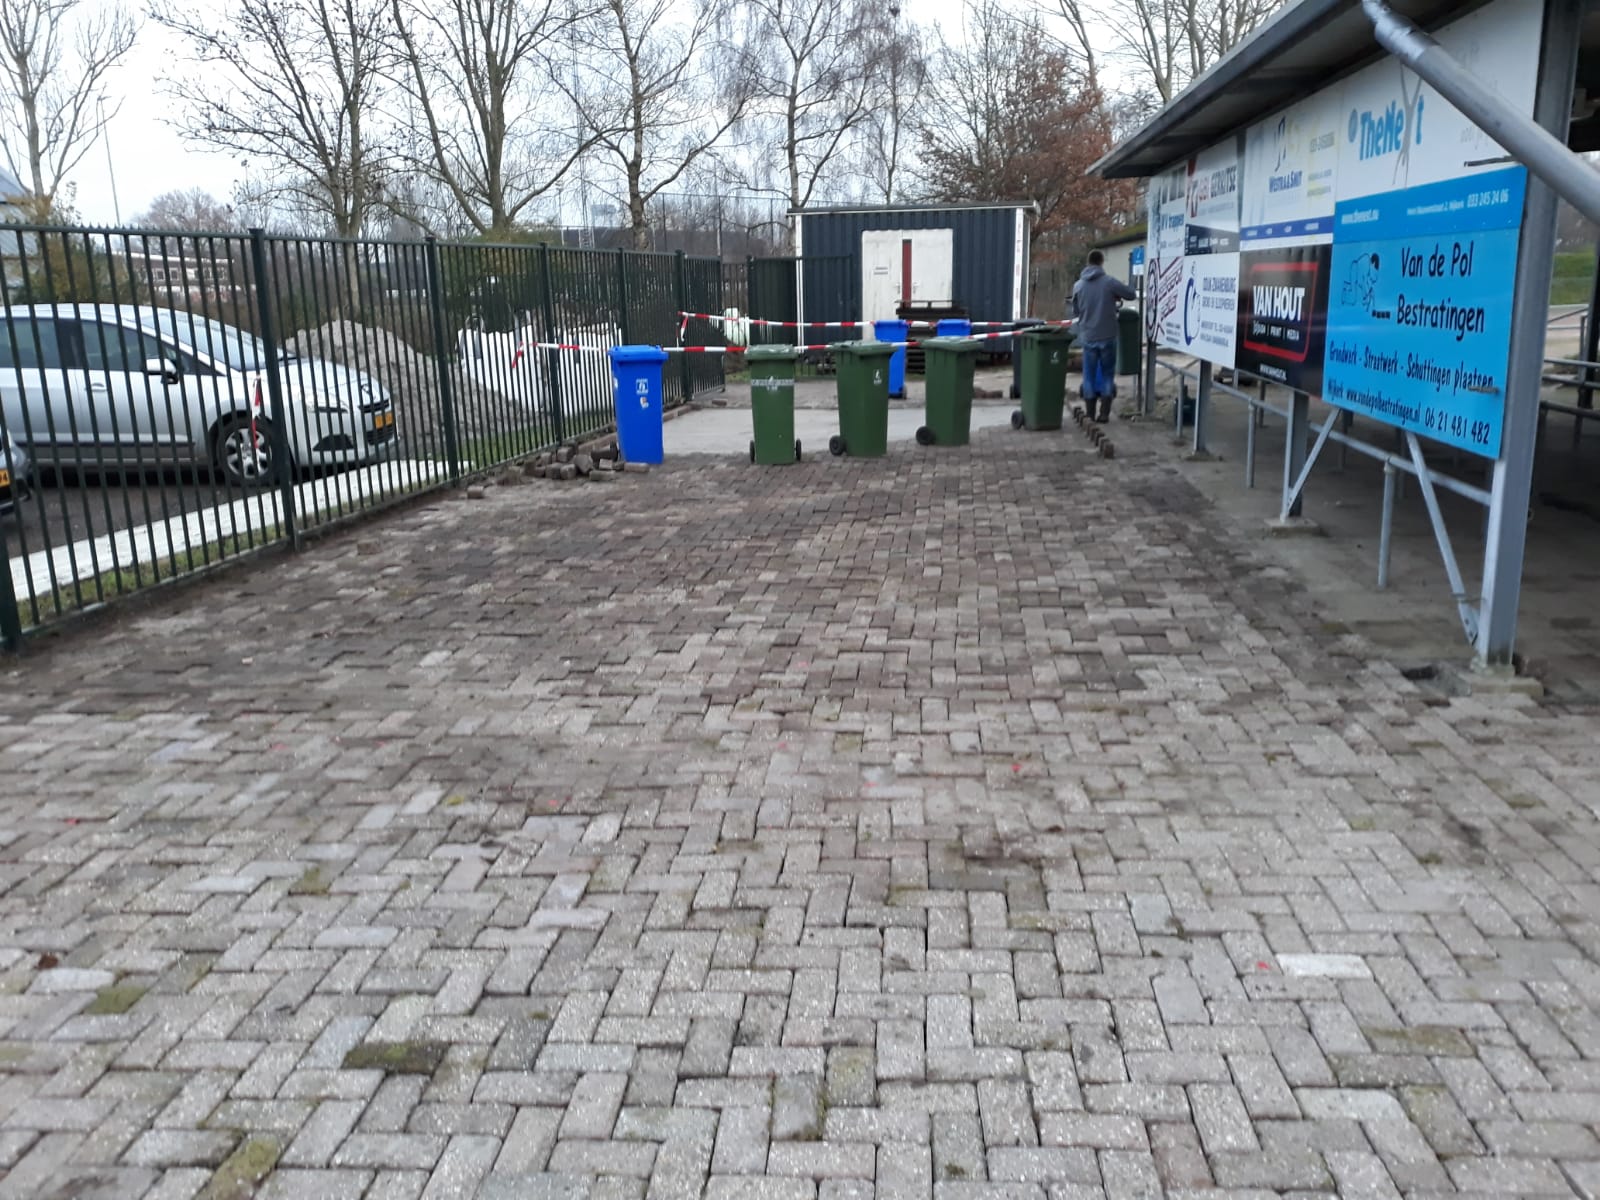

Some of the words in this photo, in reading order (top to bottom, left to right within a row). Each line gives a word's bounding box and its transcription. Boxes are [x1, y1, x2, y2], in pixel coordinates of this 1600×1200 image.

[1401, 246, 1424, 279] Van
[1428, 243, 1446, 278] de
[1450, 239, 1475, 278] Pol
[1253, 285, 1273, 318] VAN
[1273, 286, 1305, 323] HOUT
[1396, 293, 1485, 342] Bestratingen
[1363, 345, 1399, 375] Straatwerk
[1406, 351, 1451, 393] Schuttingen
[1453, 360, 1494, 396] plaatsen
[1424, 406, 1436, 428] 06
[1437, 409, 1449, 433] 21
[1451, 415, 1467, 439] 481
[1471, 419, 1491, 446] 482
